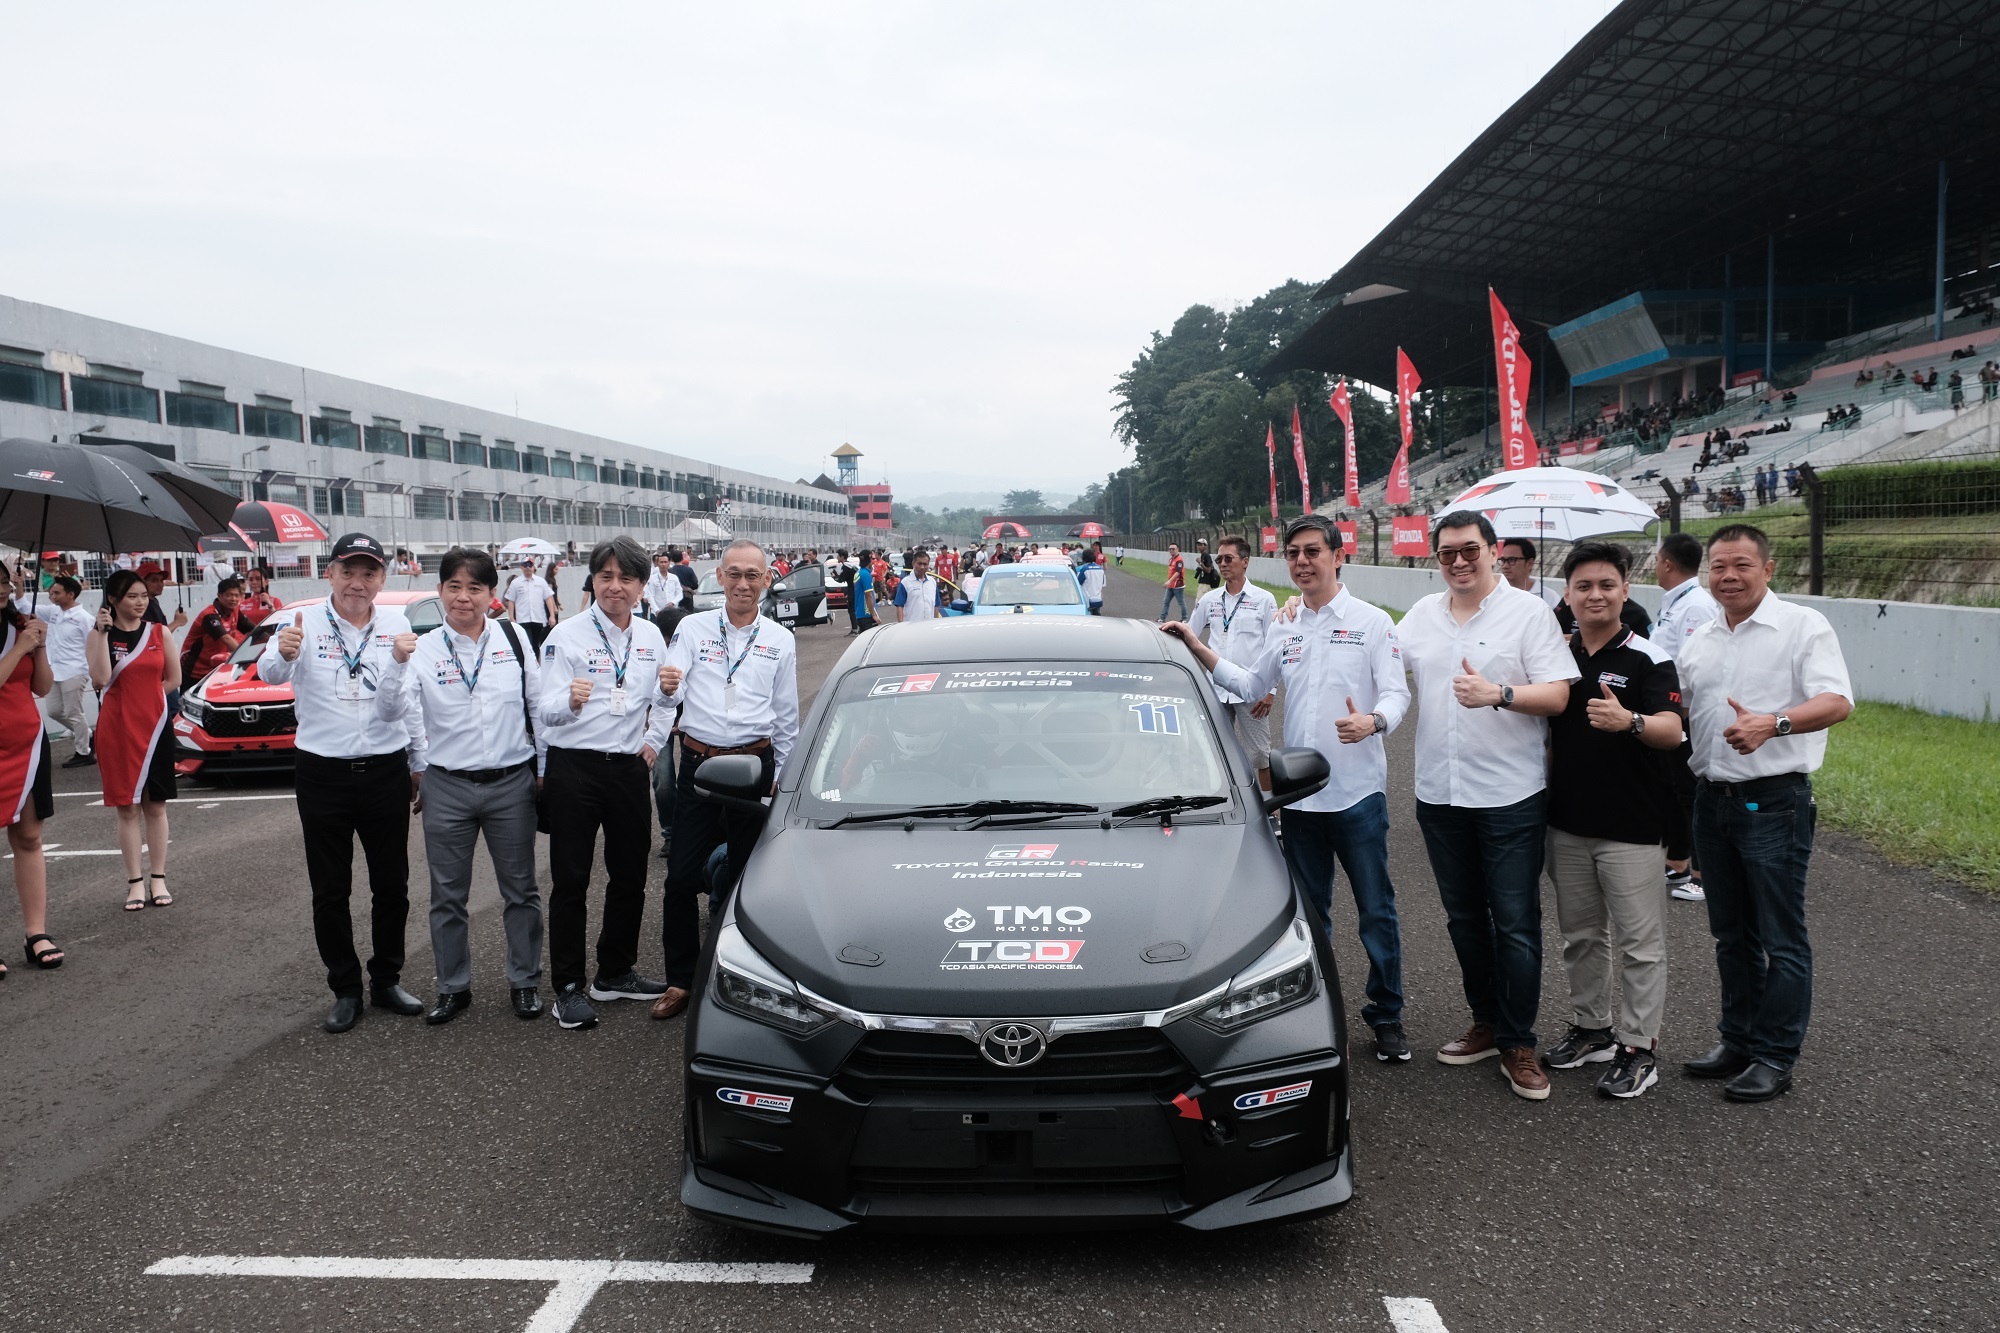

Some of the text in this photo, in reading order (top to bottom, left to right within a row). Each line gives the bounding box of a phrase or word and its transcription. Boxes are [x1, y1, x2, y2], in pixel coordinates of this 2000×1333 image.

[1341, 532, 1353, 543] NDA
[1399, 530, 1424, 543] HONDA
[784, 603, 791, 613] 9
[780, 619, 796, 627] TMO
[1288, 635, 1304, 643] TMO
[1329, 639, 1365, 647] Indonesia
[1094, 671, 1154, 682] Racing
[871, 679, 934, 696] GR
[945, 677, 1073, 689] Indonesia
[1121, 692, 1186, 704] AMATO
[1128, 701, 1182, 736] 11
[988, 848, 1055, 859] GR
[891, 859, 1145, 870] TOYOTA GAZOO Racing
[951, 870, 1083, 879] Indonesia
[986, 905, 1092, 926] TMO
[957, 941, 1070, 961] TCD
[717, 1089, 790, 1107] GT RADIAL
[1235, 1087, 1309, 1108] GT RADIAL
